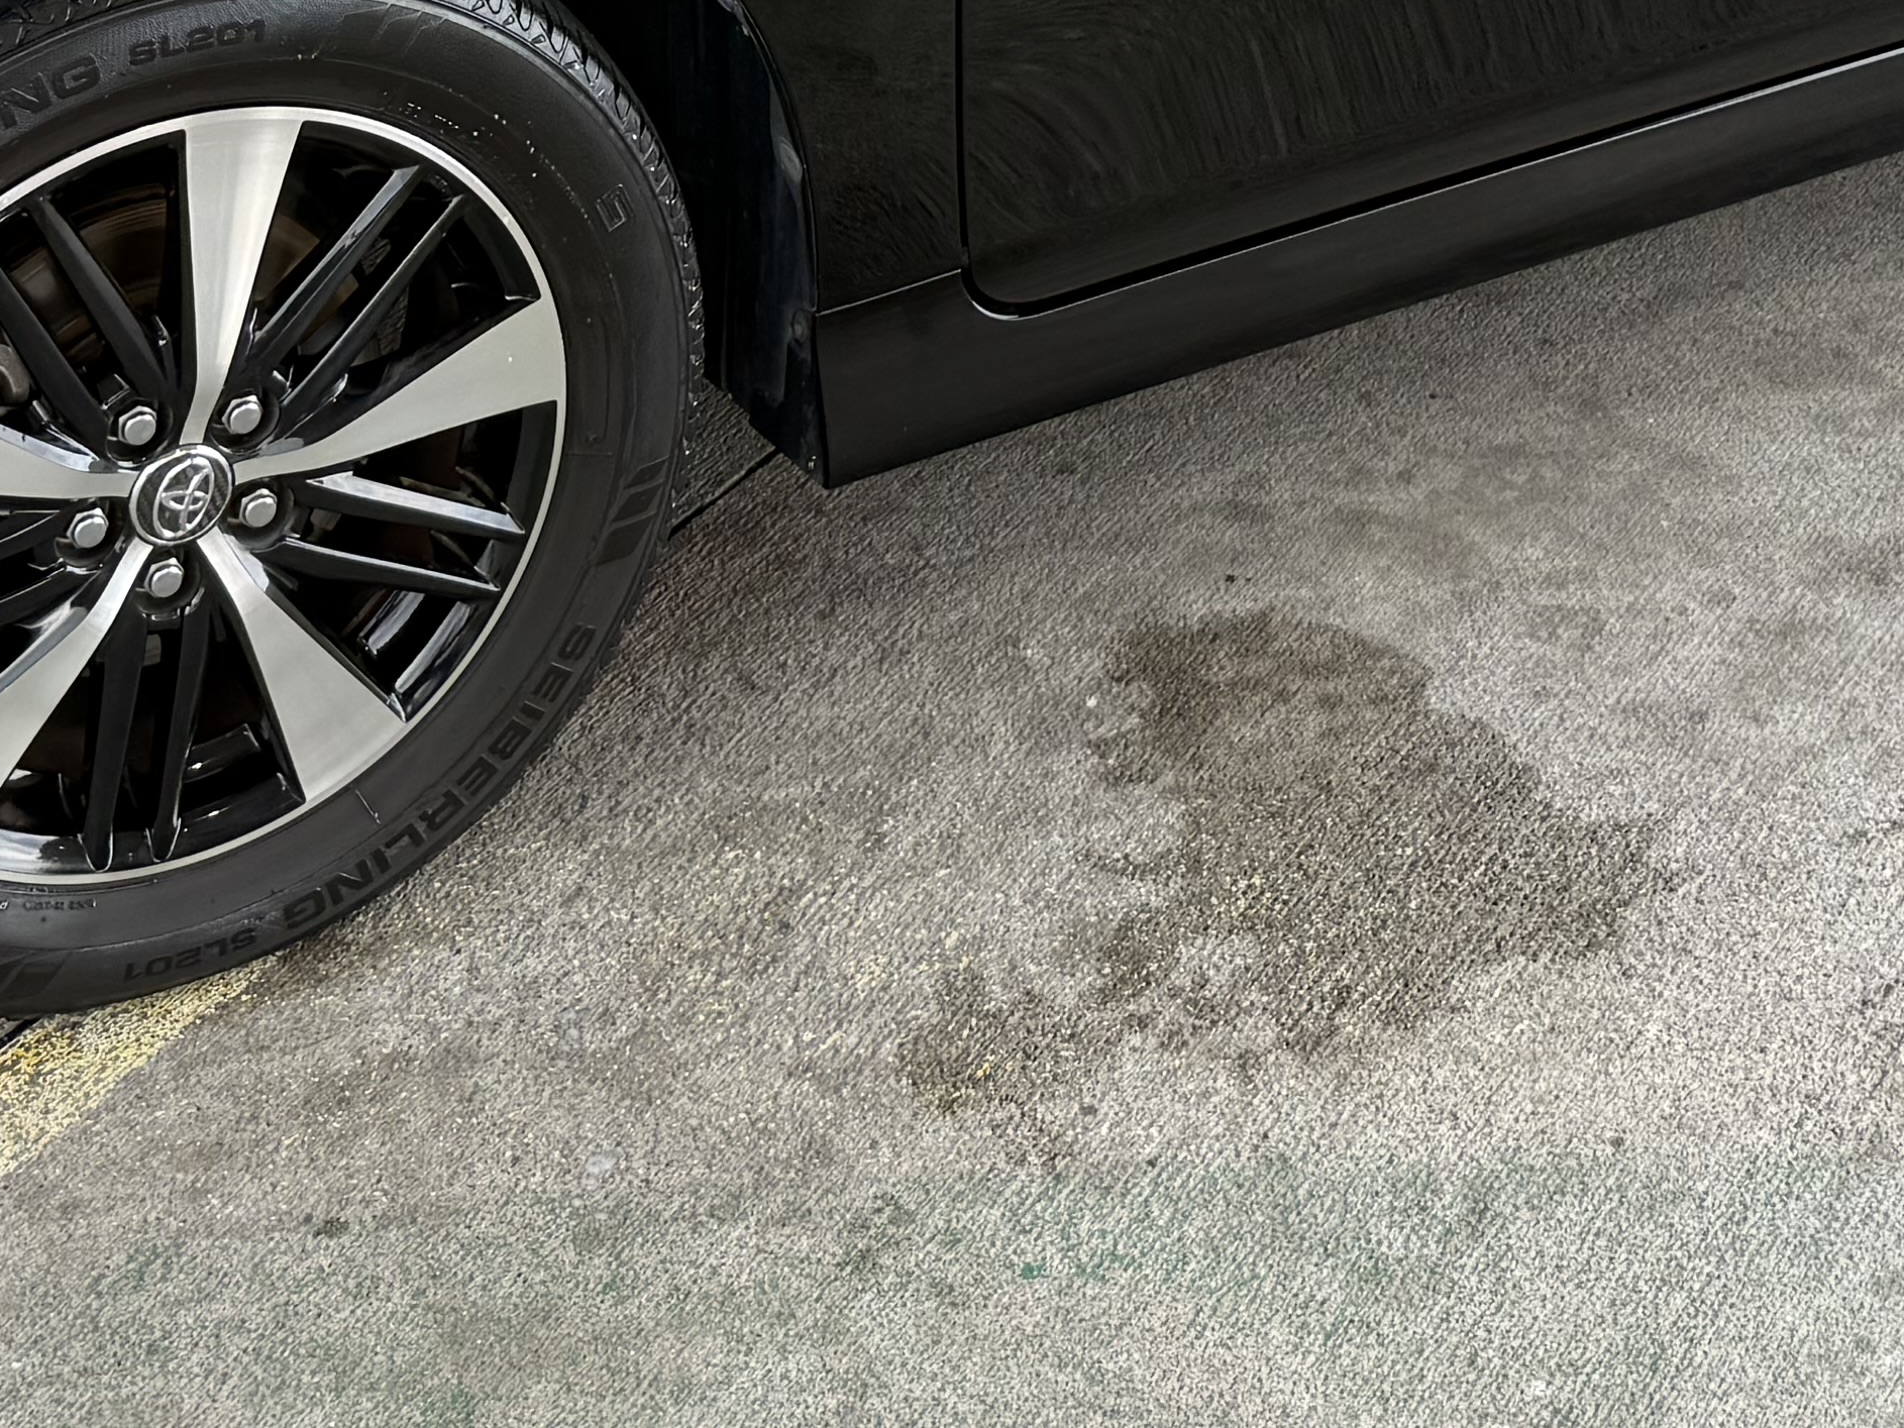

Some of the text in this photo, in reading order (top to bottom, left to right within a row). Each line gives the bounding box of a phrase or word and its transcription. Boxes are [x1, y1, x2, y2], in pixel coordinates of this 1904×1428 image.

[128, 17, 266, 67] SL201
[123, 622, 598, 984] SEIBERLING SL201
